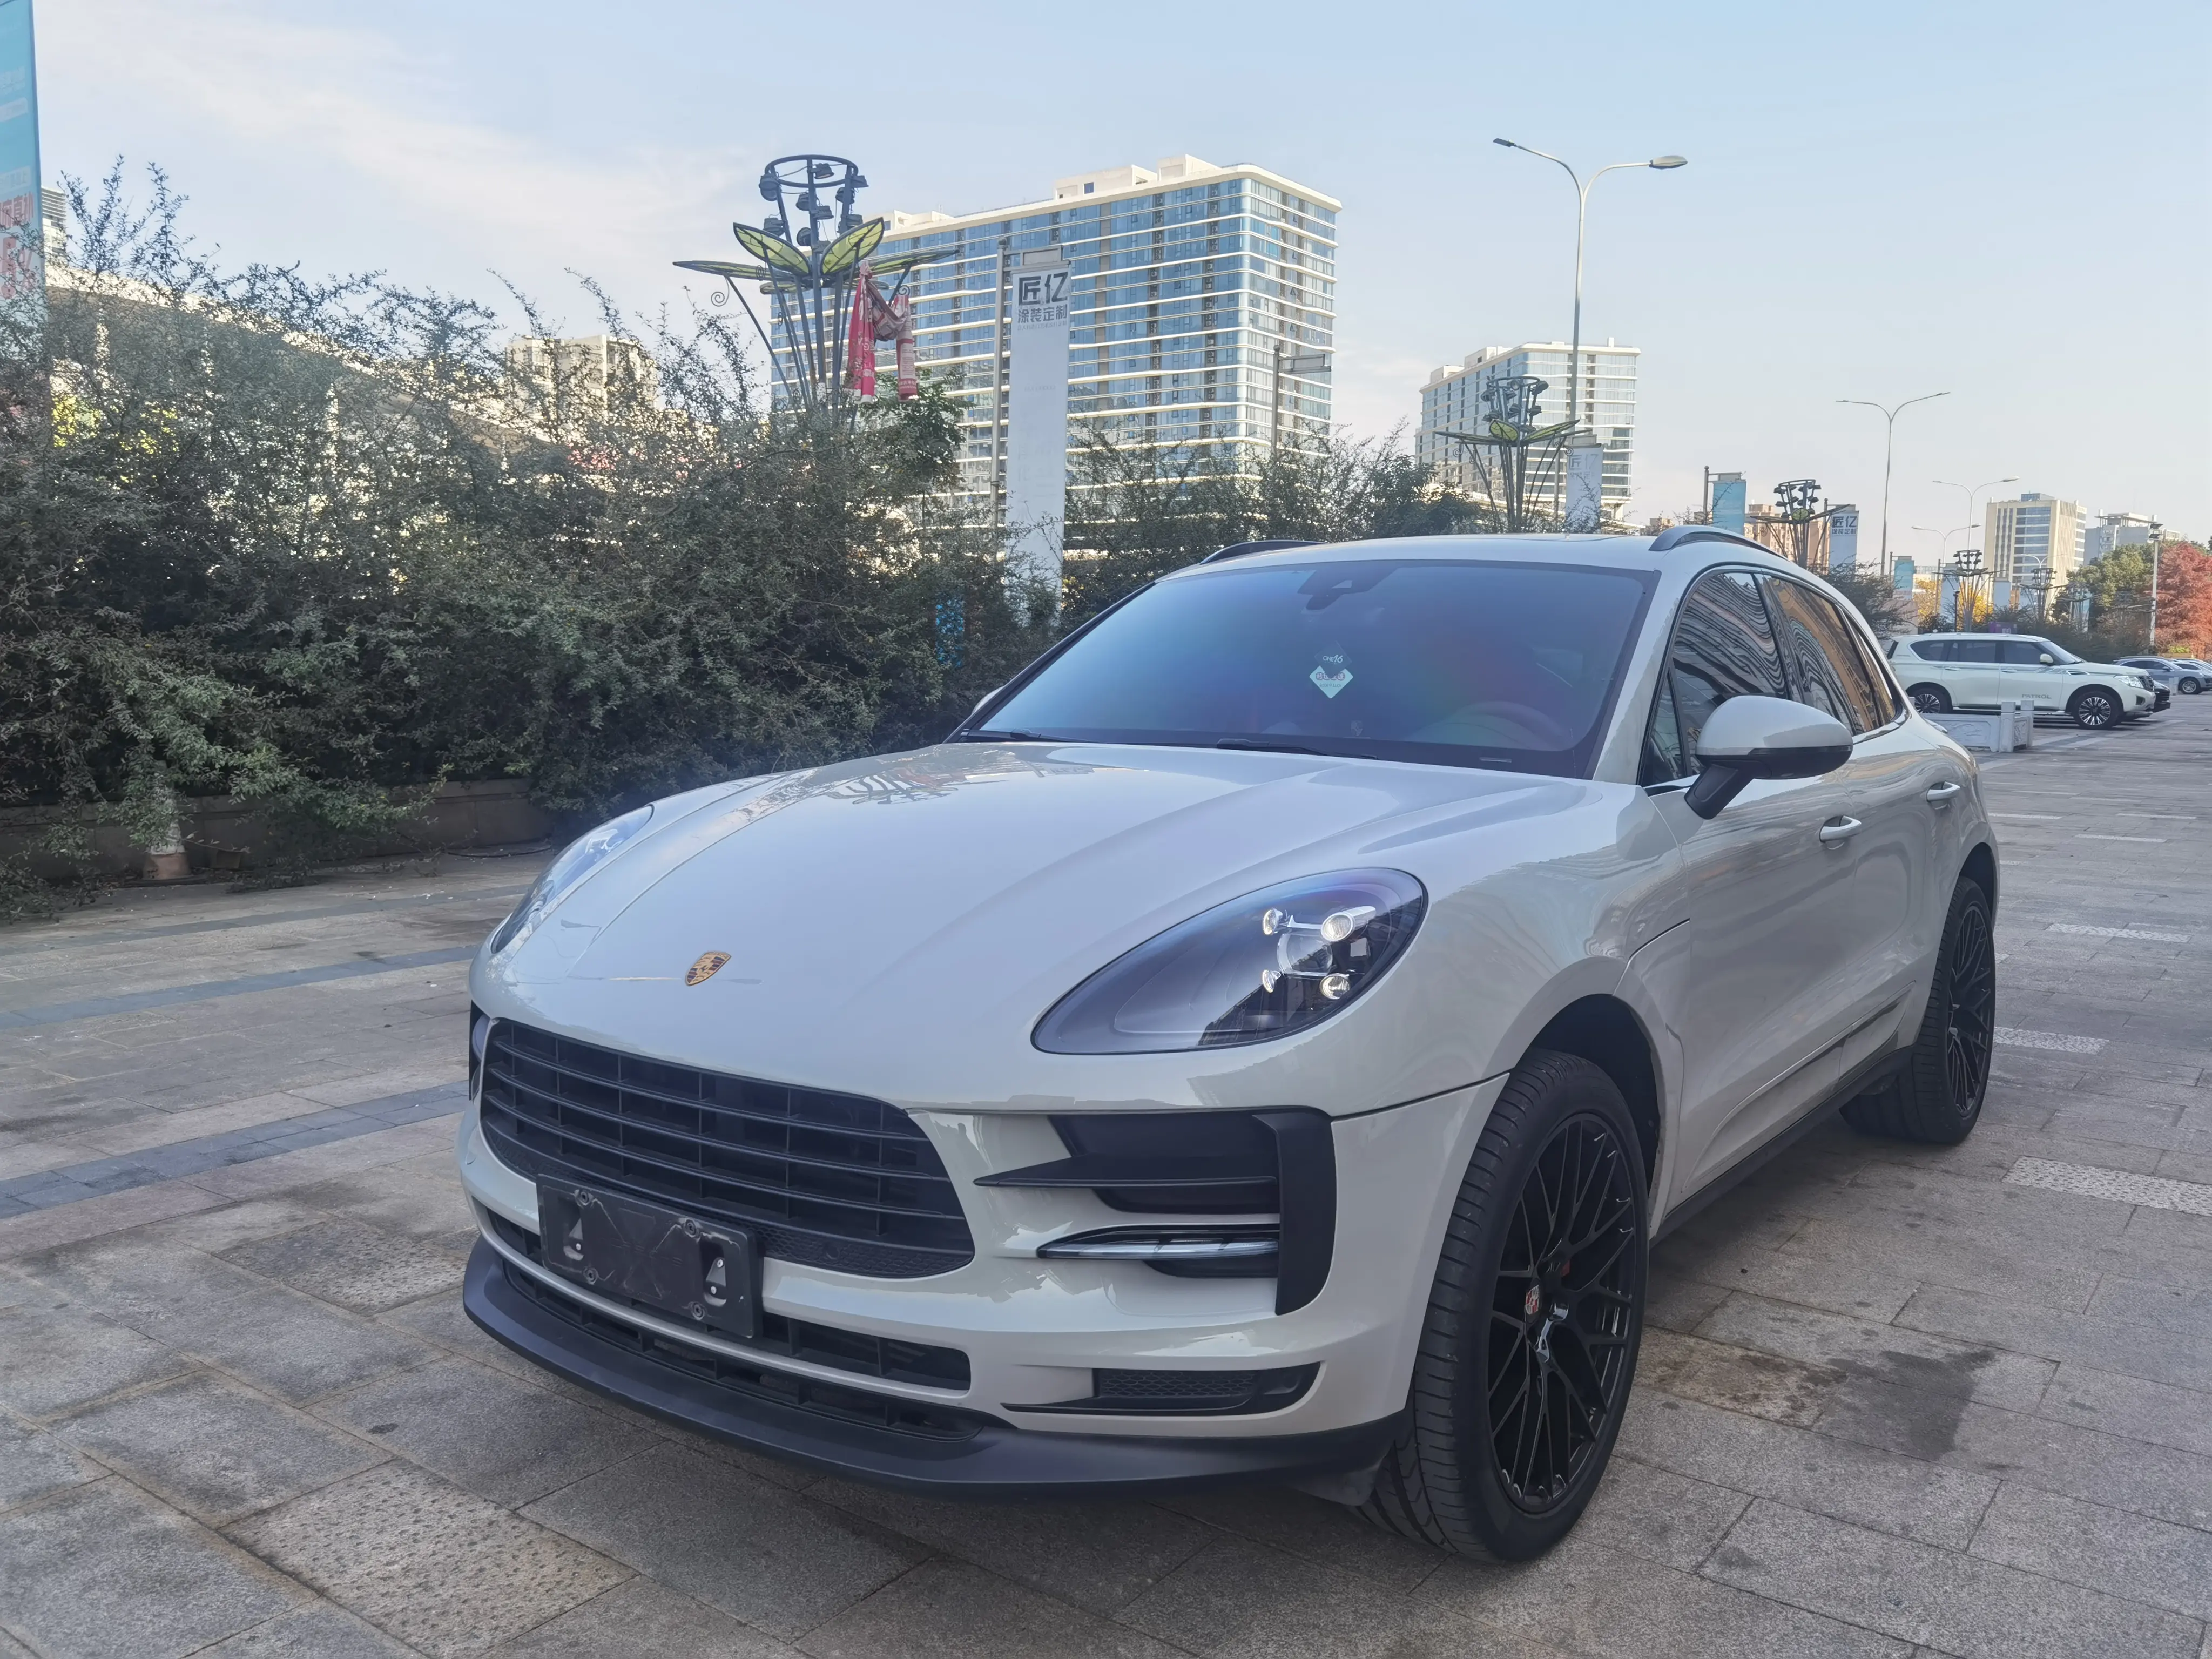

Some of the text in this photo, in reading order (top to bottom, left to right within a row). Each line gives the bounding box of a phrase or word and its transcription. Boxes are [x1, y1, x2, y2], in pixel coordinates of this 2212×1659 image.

[1019, 272, 1068, 306] 匠亿
[1017, 304, 1068, 323] 涂装定制
[1832, 516, 1857, 528] 匠亿
